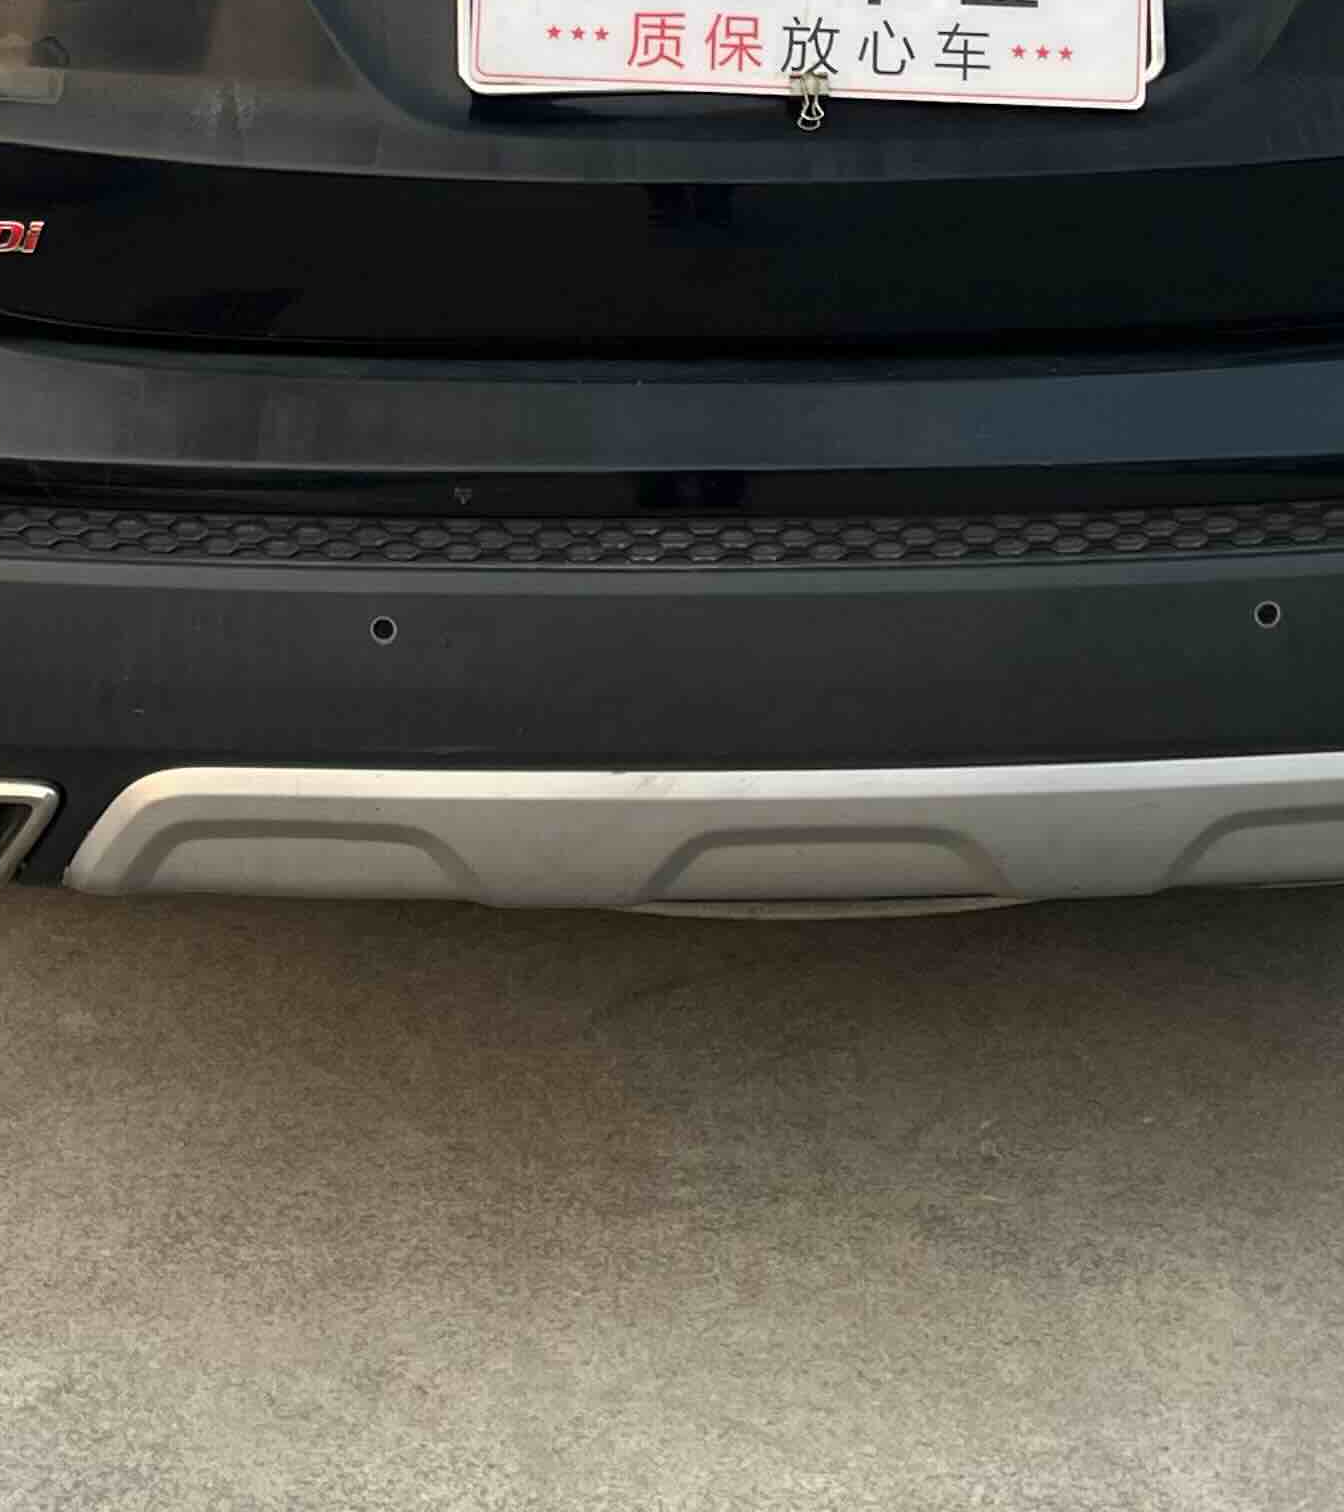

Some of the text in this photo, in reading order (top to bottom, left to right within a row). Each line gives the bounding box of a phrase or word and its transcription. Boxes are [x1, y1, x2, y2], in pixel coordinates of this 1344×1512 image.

[626, 12, 992, 81] 质保放心车
